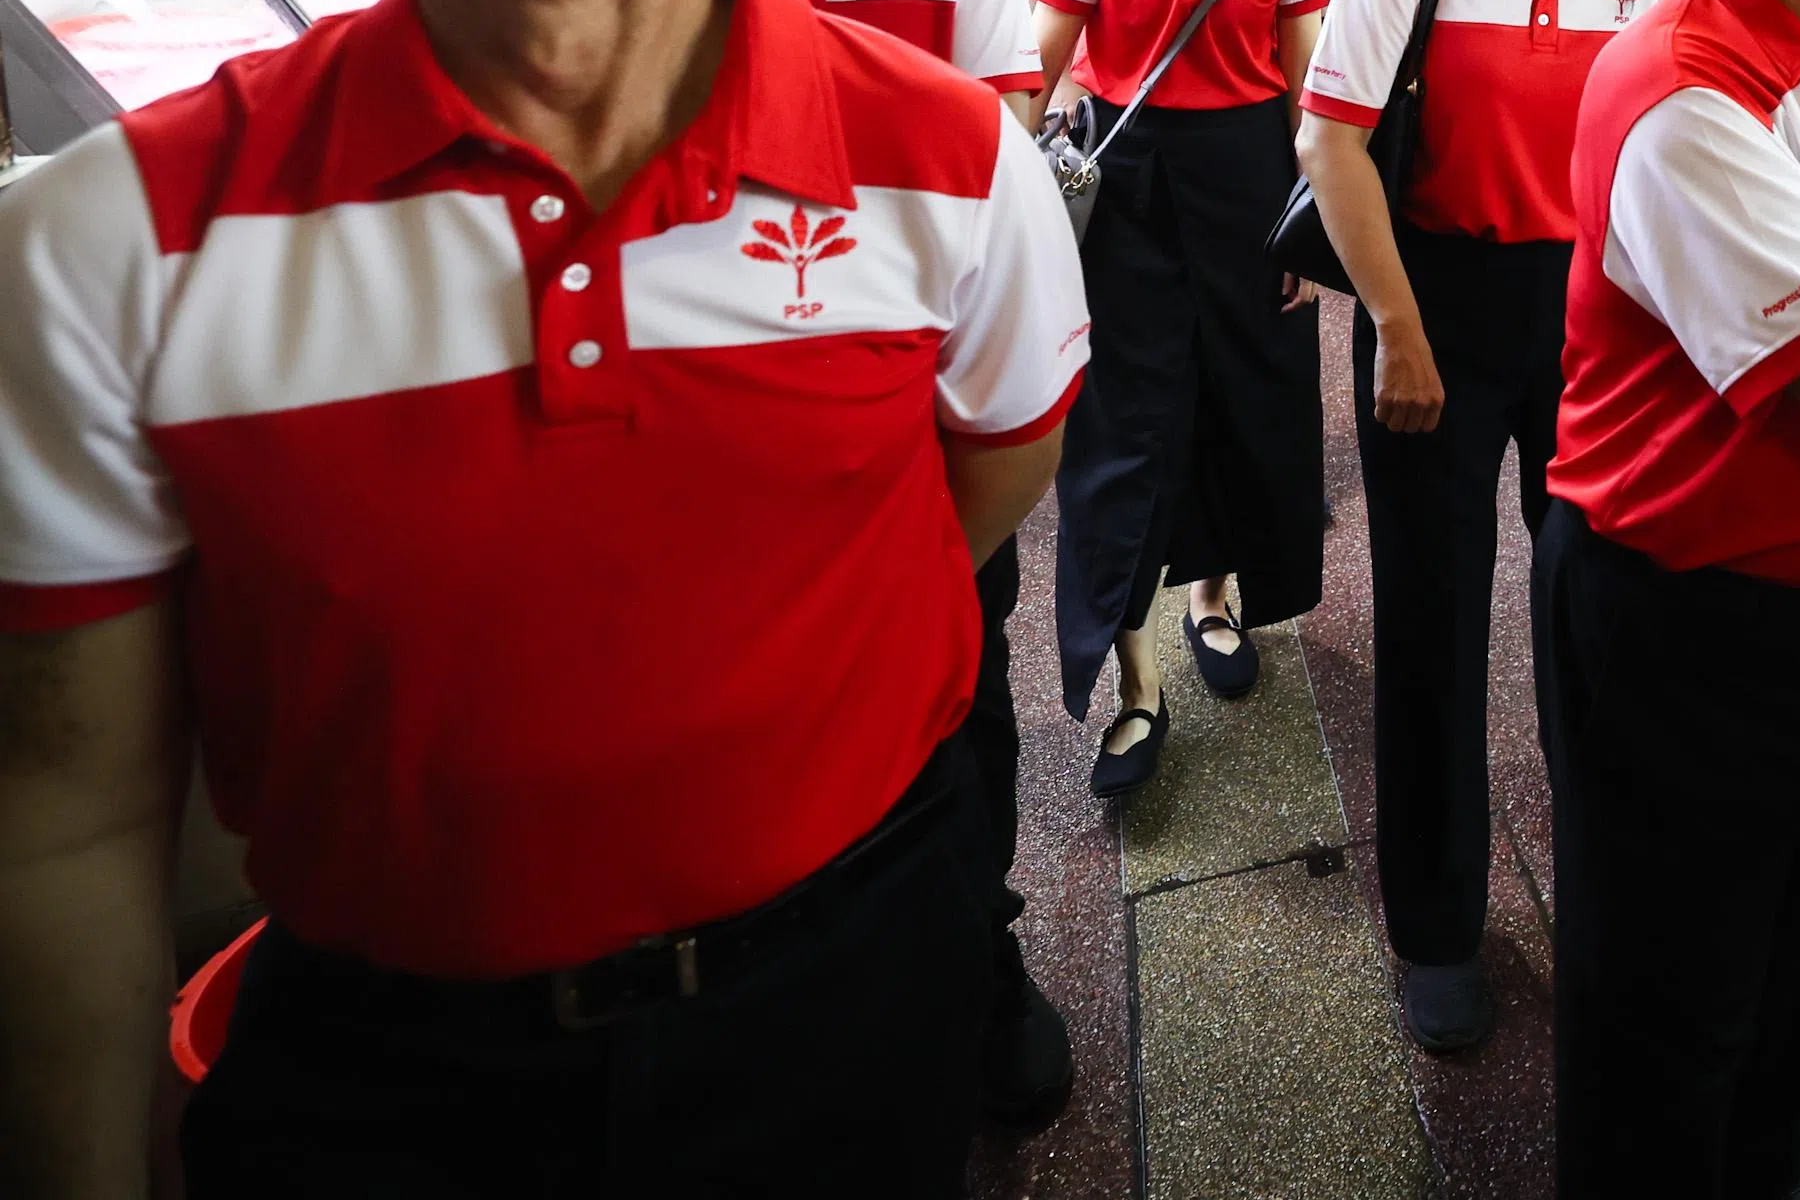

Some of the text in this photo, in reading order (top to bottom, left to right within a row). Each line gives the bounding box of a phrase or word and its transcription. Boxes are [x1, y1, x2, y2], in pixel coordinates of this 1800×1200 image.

[1614, 16, 1630, 24] PSP
[784, 302, 825, 320] PSP
[1762, 291, 1800, 319] Progress
